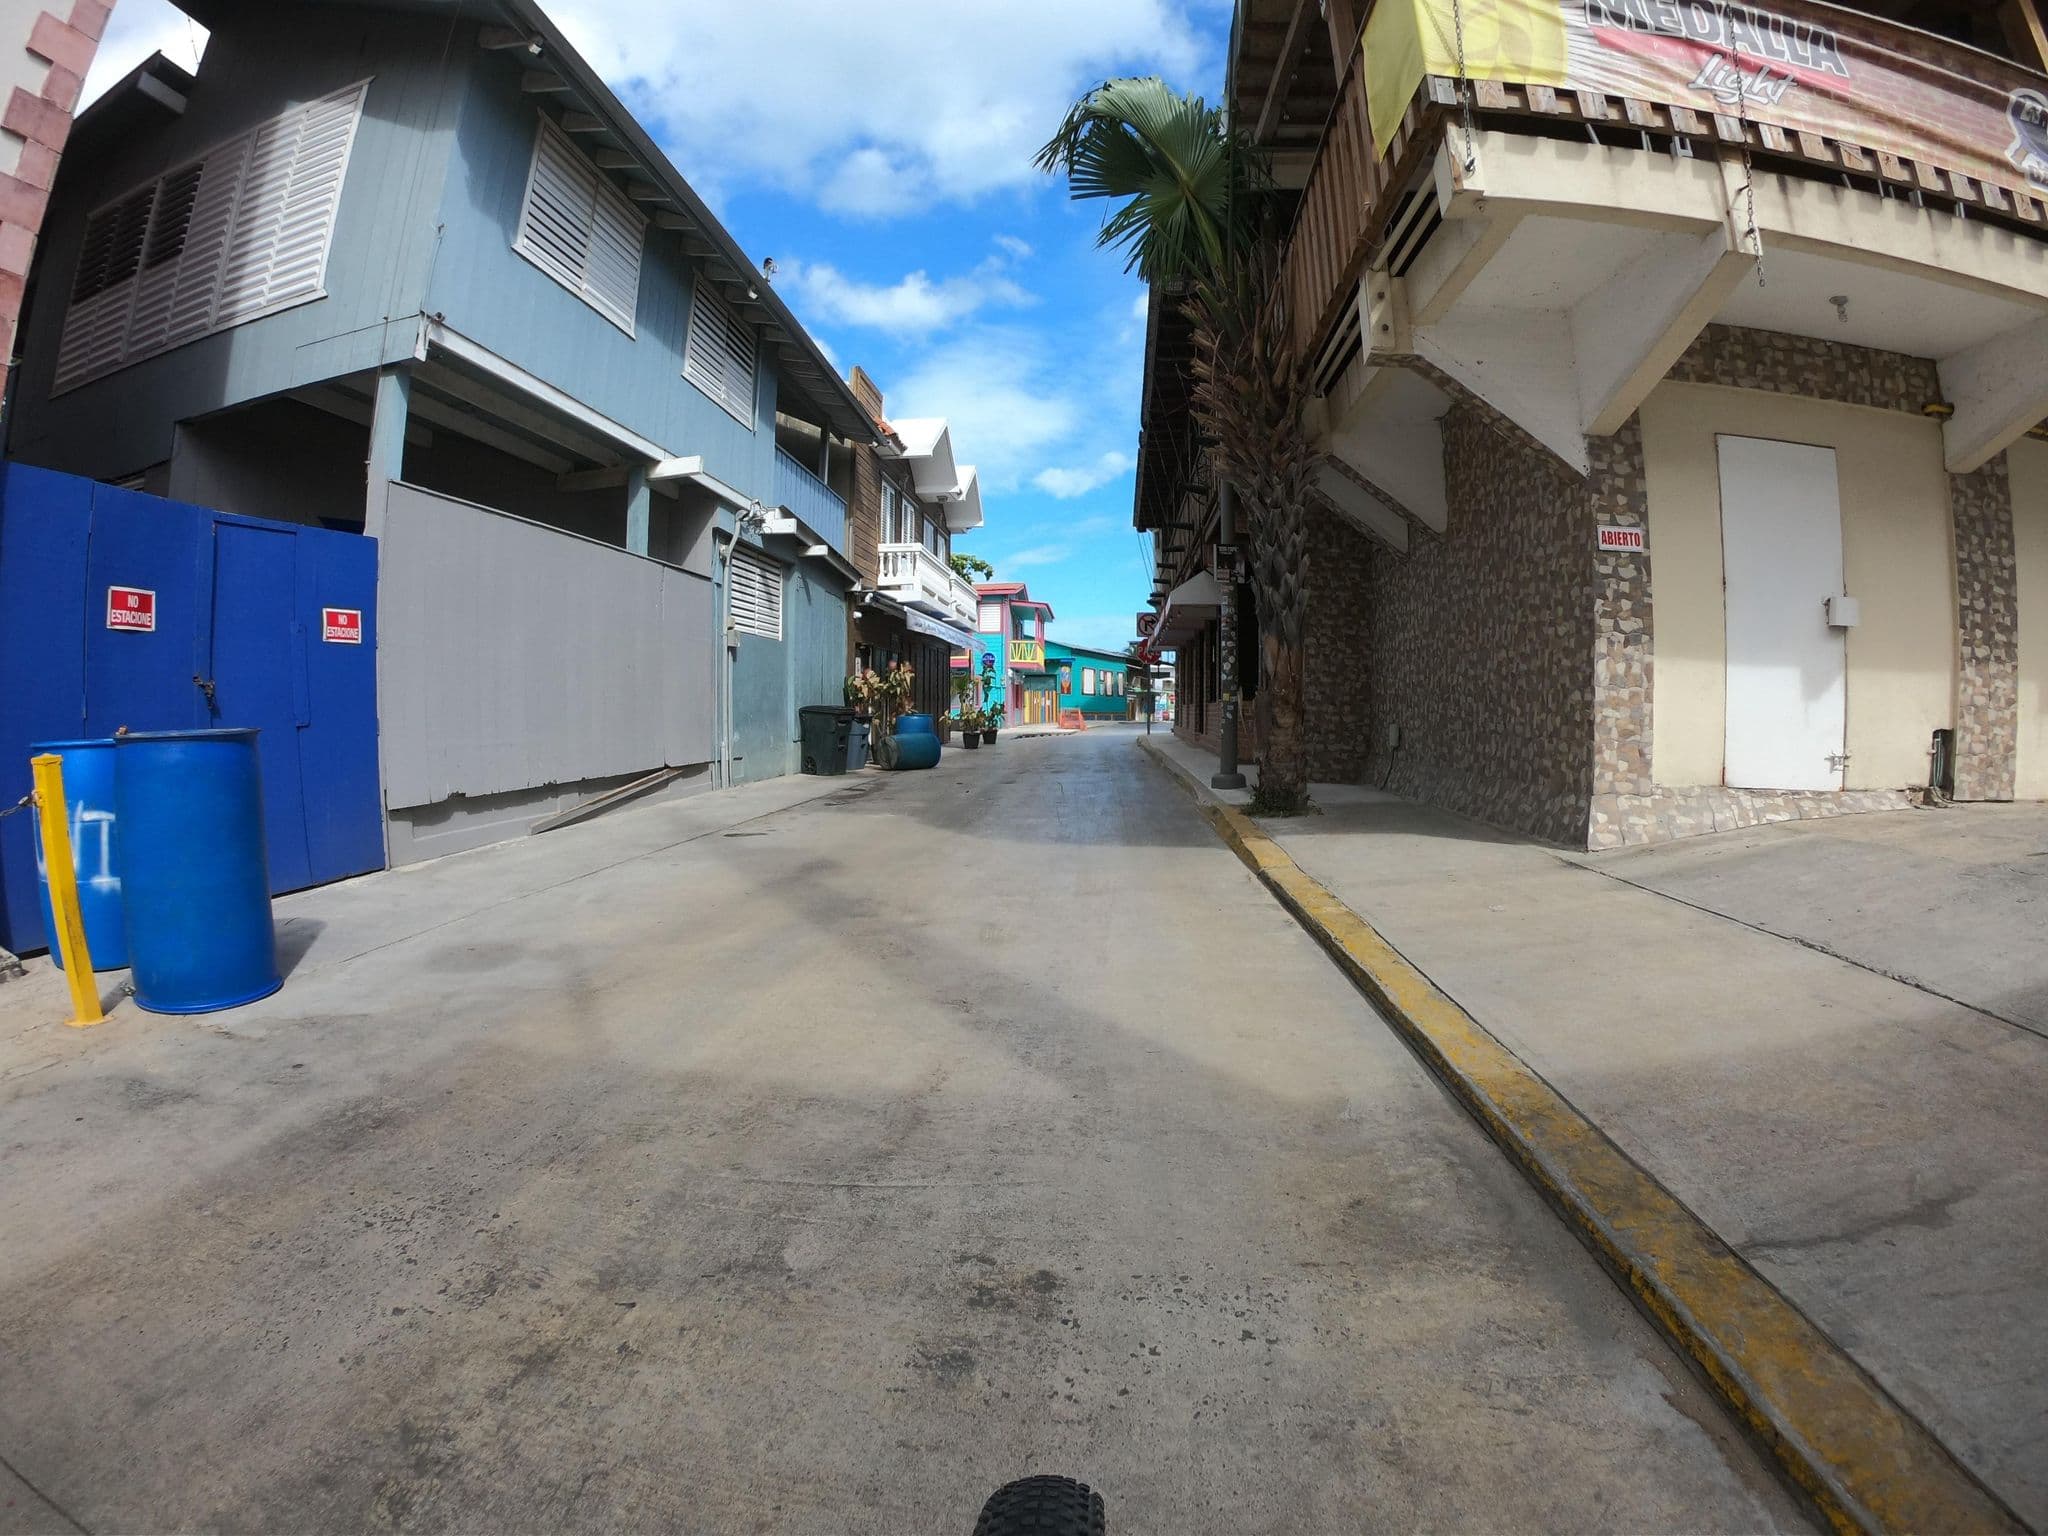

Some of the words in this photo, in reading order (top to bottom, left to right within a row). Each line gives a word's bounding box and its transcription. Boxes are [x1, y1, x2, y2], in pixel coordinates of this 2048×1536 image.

[1584, 0, 1849, 78] MEDALLA
[1686, 52, 1798, 105] Light
[1601, 530, 1641, 547] ABIERTO
[127, 594, 139, 608] NO
[111, 609, 152, 626] ESTACIONE
[337, 614, 348, 625] NO
[327, 626, 359, 638] ESTACIONE
